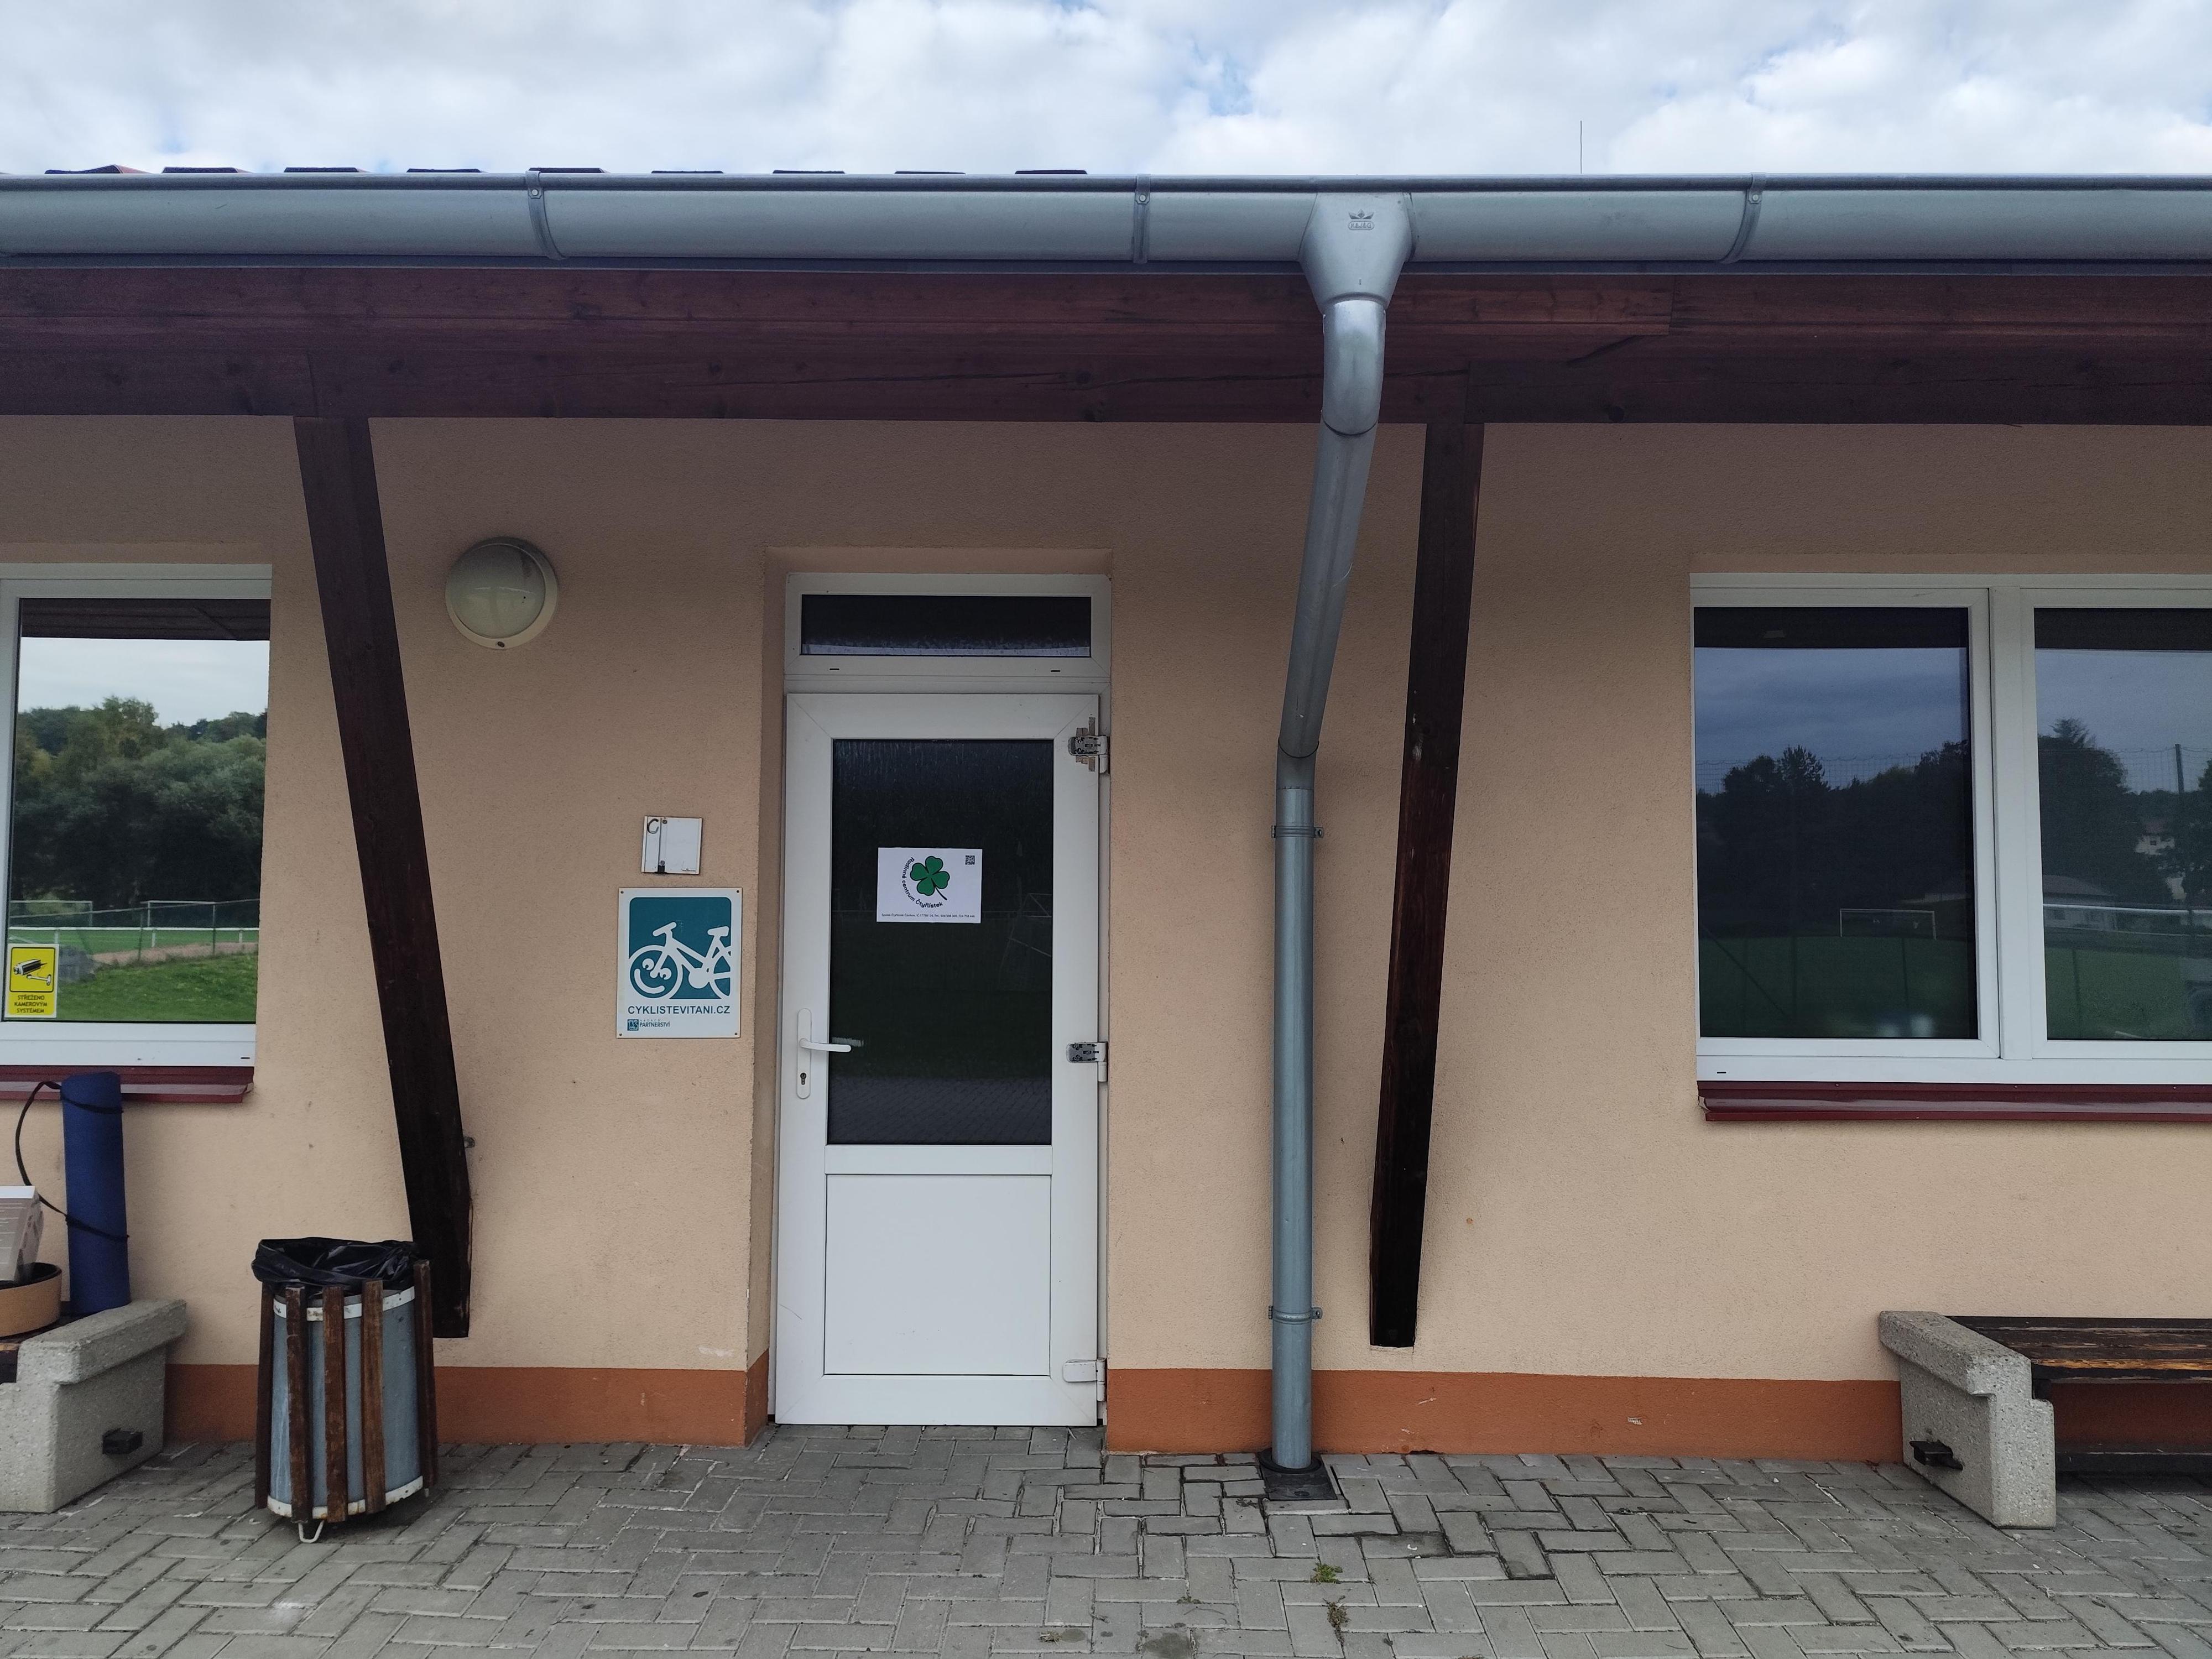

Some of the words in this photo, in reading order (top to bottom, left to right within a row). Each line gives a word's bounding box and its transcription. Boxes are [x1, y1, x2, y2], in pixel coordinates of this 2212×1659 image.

[902, 880, 915, 901] centrum
[915, 899, 943, 908] Čtyřlístek
[628, 1005, 731, 1014] CYKLISTEVITANI.CZ
